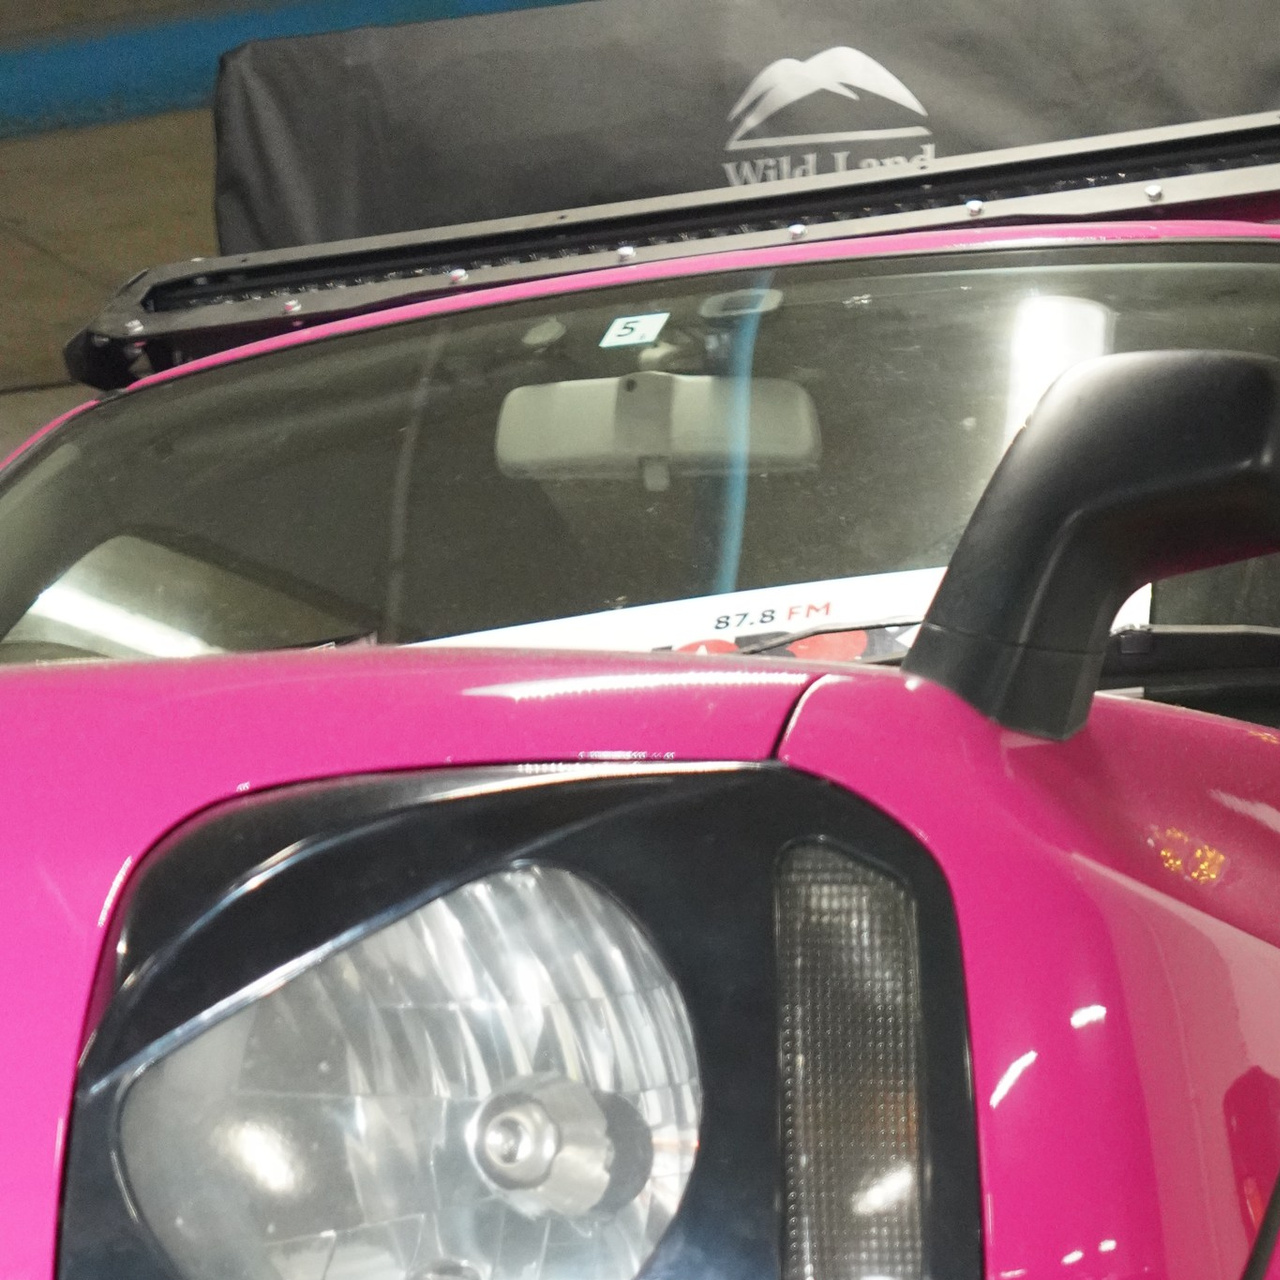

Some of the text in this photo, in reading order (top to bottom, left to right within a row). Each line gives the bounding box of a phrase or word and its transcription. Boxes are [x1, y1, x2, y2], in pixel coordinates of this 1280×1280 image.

[721, 153, 817, 187] Wild
[714, 602, 831, 631] 87.8 FM
